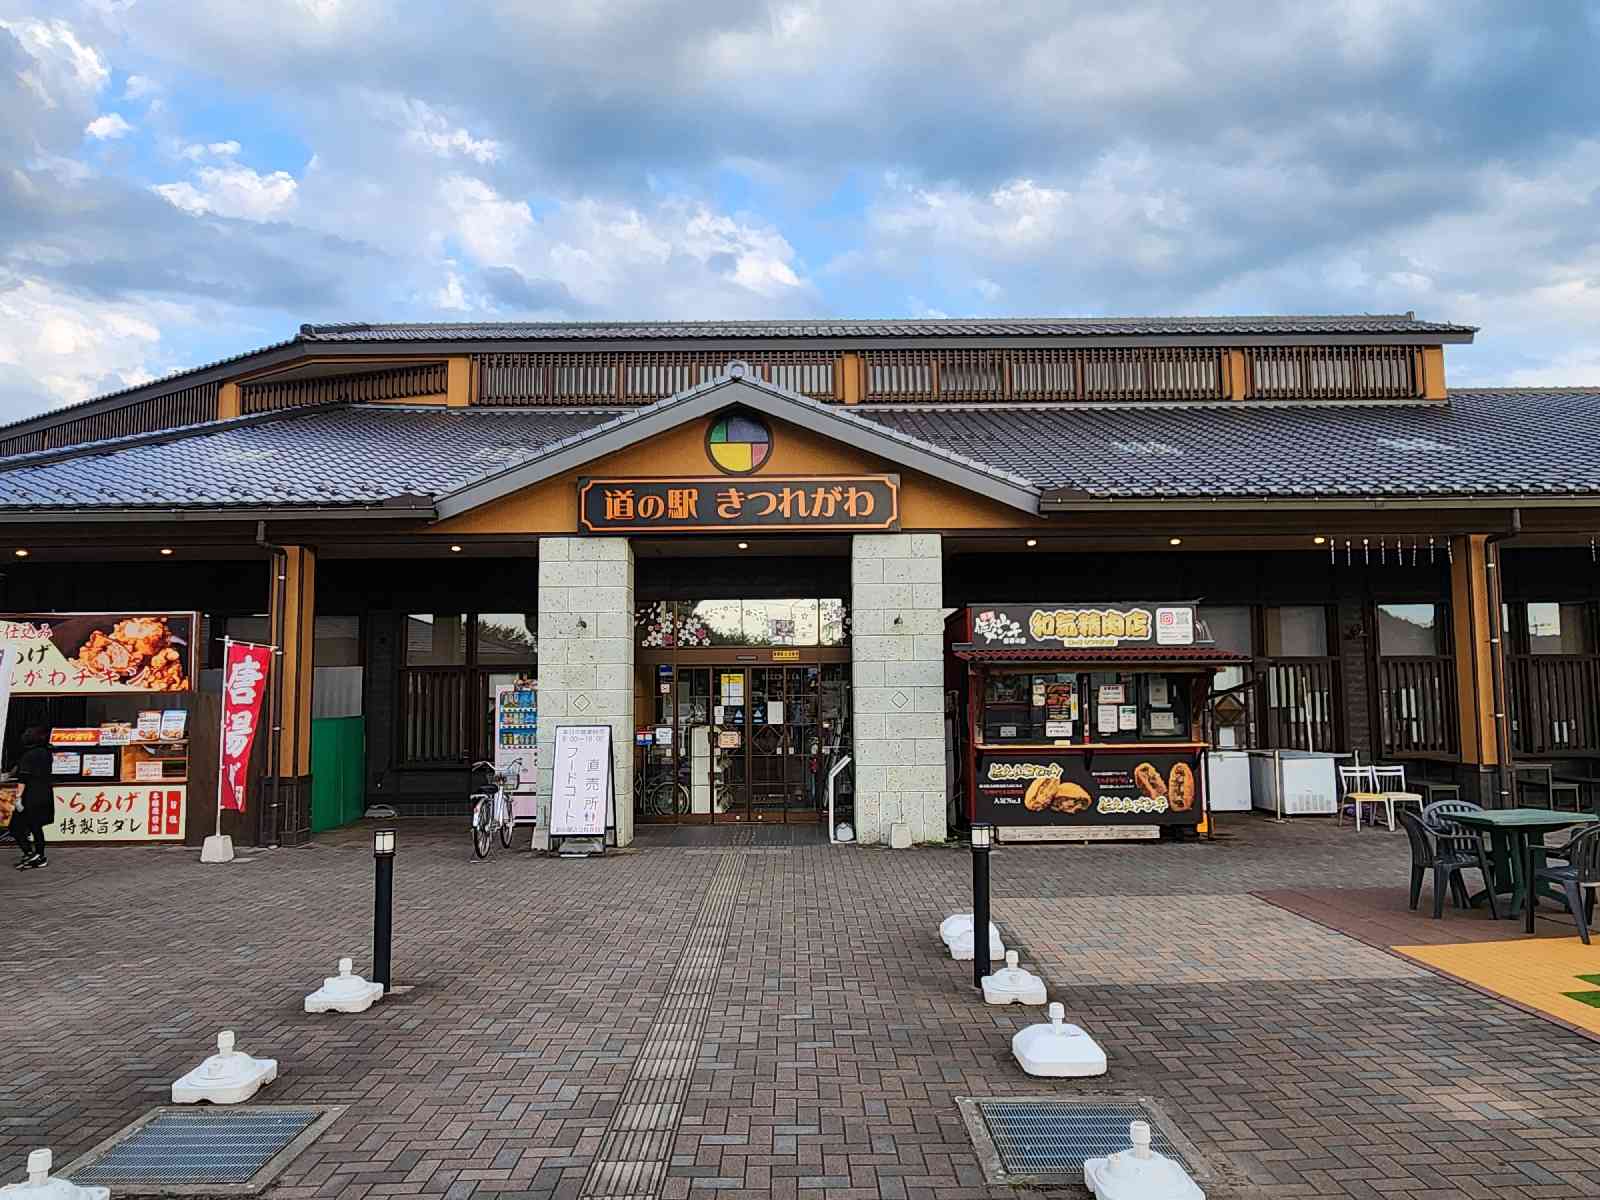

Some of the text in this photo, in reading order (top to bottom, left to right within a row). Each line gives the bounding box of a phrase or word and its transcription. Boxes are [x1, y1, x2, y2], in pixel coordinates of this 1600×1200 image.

[604, 486, 874, 520] 道の駅 きつれがわ
[0, 624, 53, 640] 仕込み
[563, 747, 578, 824] フードコート
[584, 754, 601, 810] 直売所
[56, 791, 142, 813] らあげ
[60, 817, 142, 834] 特製旨ダレ
